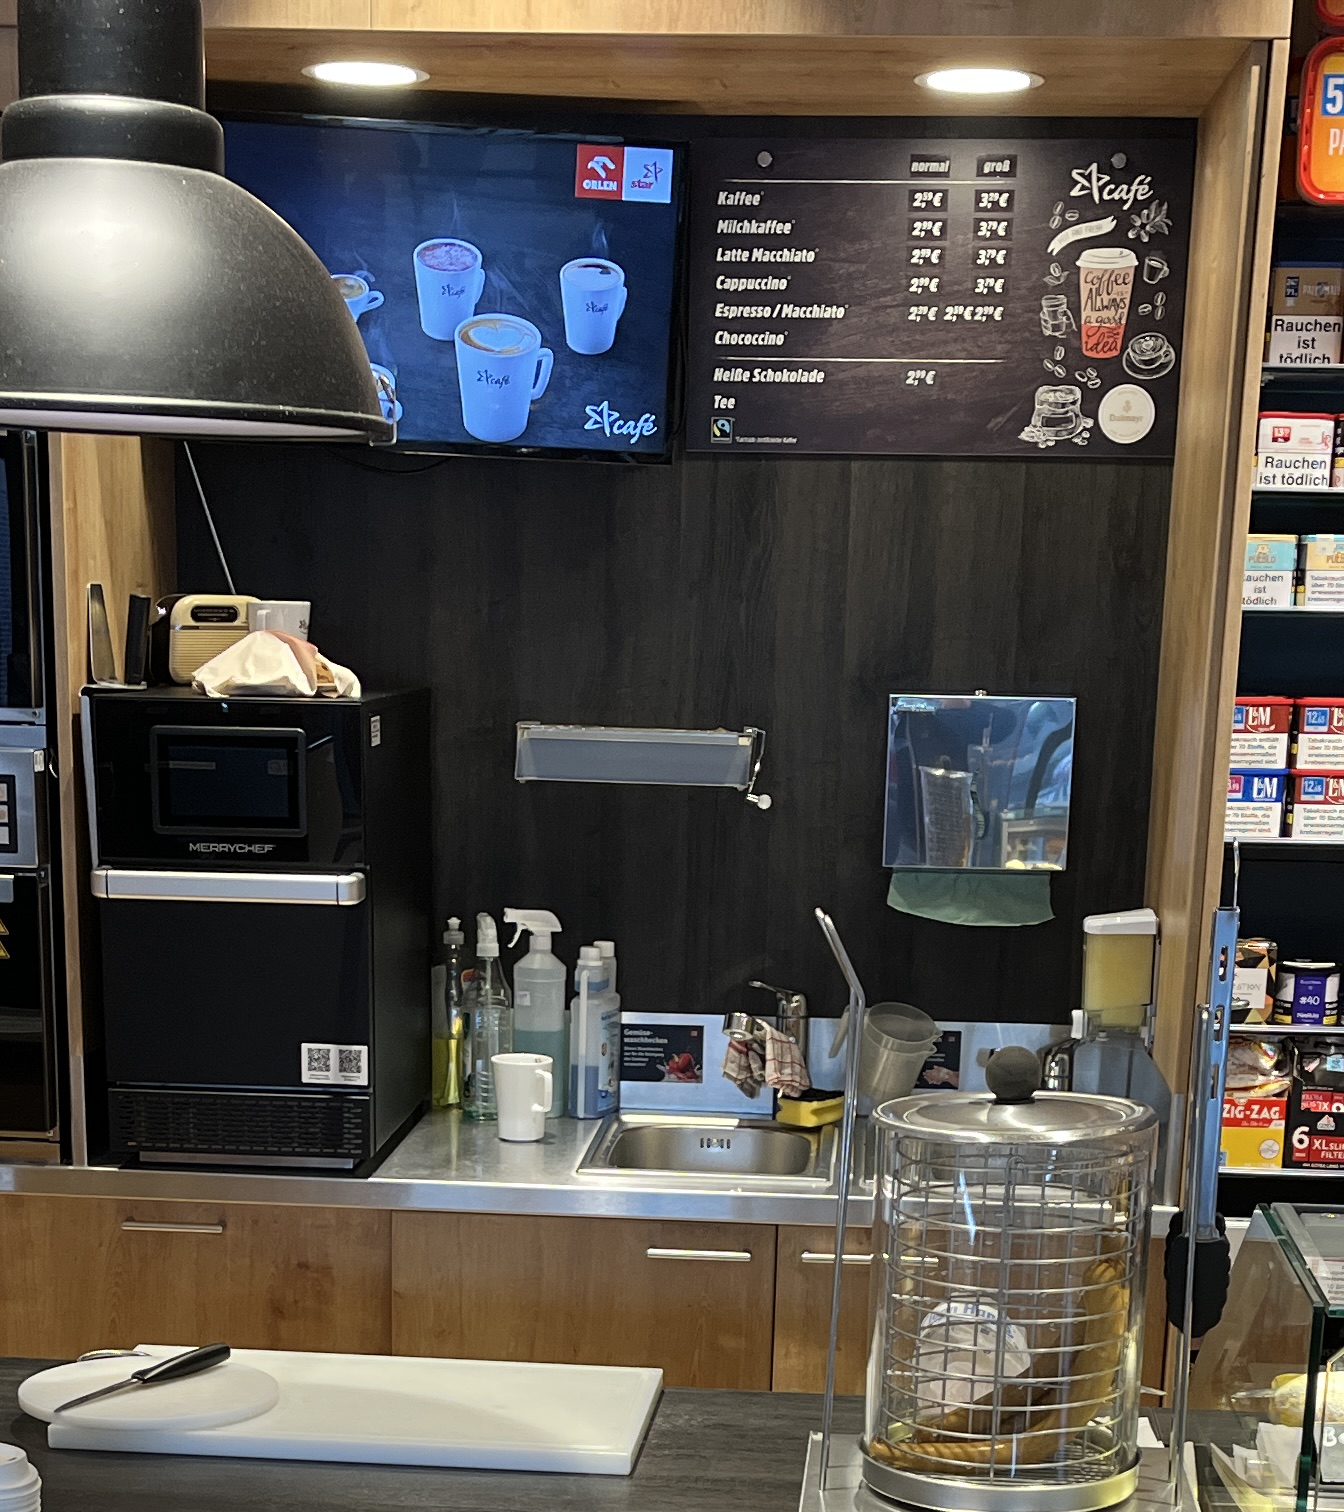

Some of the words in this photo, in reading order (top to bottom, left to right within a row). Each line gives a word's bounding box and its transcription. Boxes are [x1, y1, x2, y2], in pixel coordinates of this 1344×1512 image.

[911, 160, 949, 173] normal
[983, 160, 1010, 173] groß
[583, 179, 618, 191] ORLEN
[1102, 175, 1153, 210] café
[716, 248, 749, 262] Latte
[715, 304, 772, 319] Espresso
[1274, 319, 1341, 333] Rauchen
[1297, 337, 1316, 350] ist
[713, 368, 751, 382] Heiße
[752, 368, 825, 383] Schokolade
[714, 395, 735, 409] Tee
[612, 411, 658, 444] café
[1264, 456, 1327, 470] Rauchen
[1259, 474, 1278, 486] ist
[1281, 473, 1329, 486] tödlich
[189, 843, 276, 855] MERRYCHEF
[1299, 996, 1320, 1006] #40
[1222, 1104, 1280, 1120] ZIG-ZAG
[1292, 1126, 1310, 1149] 6
